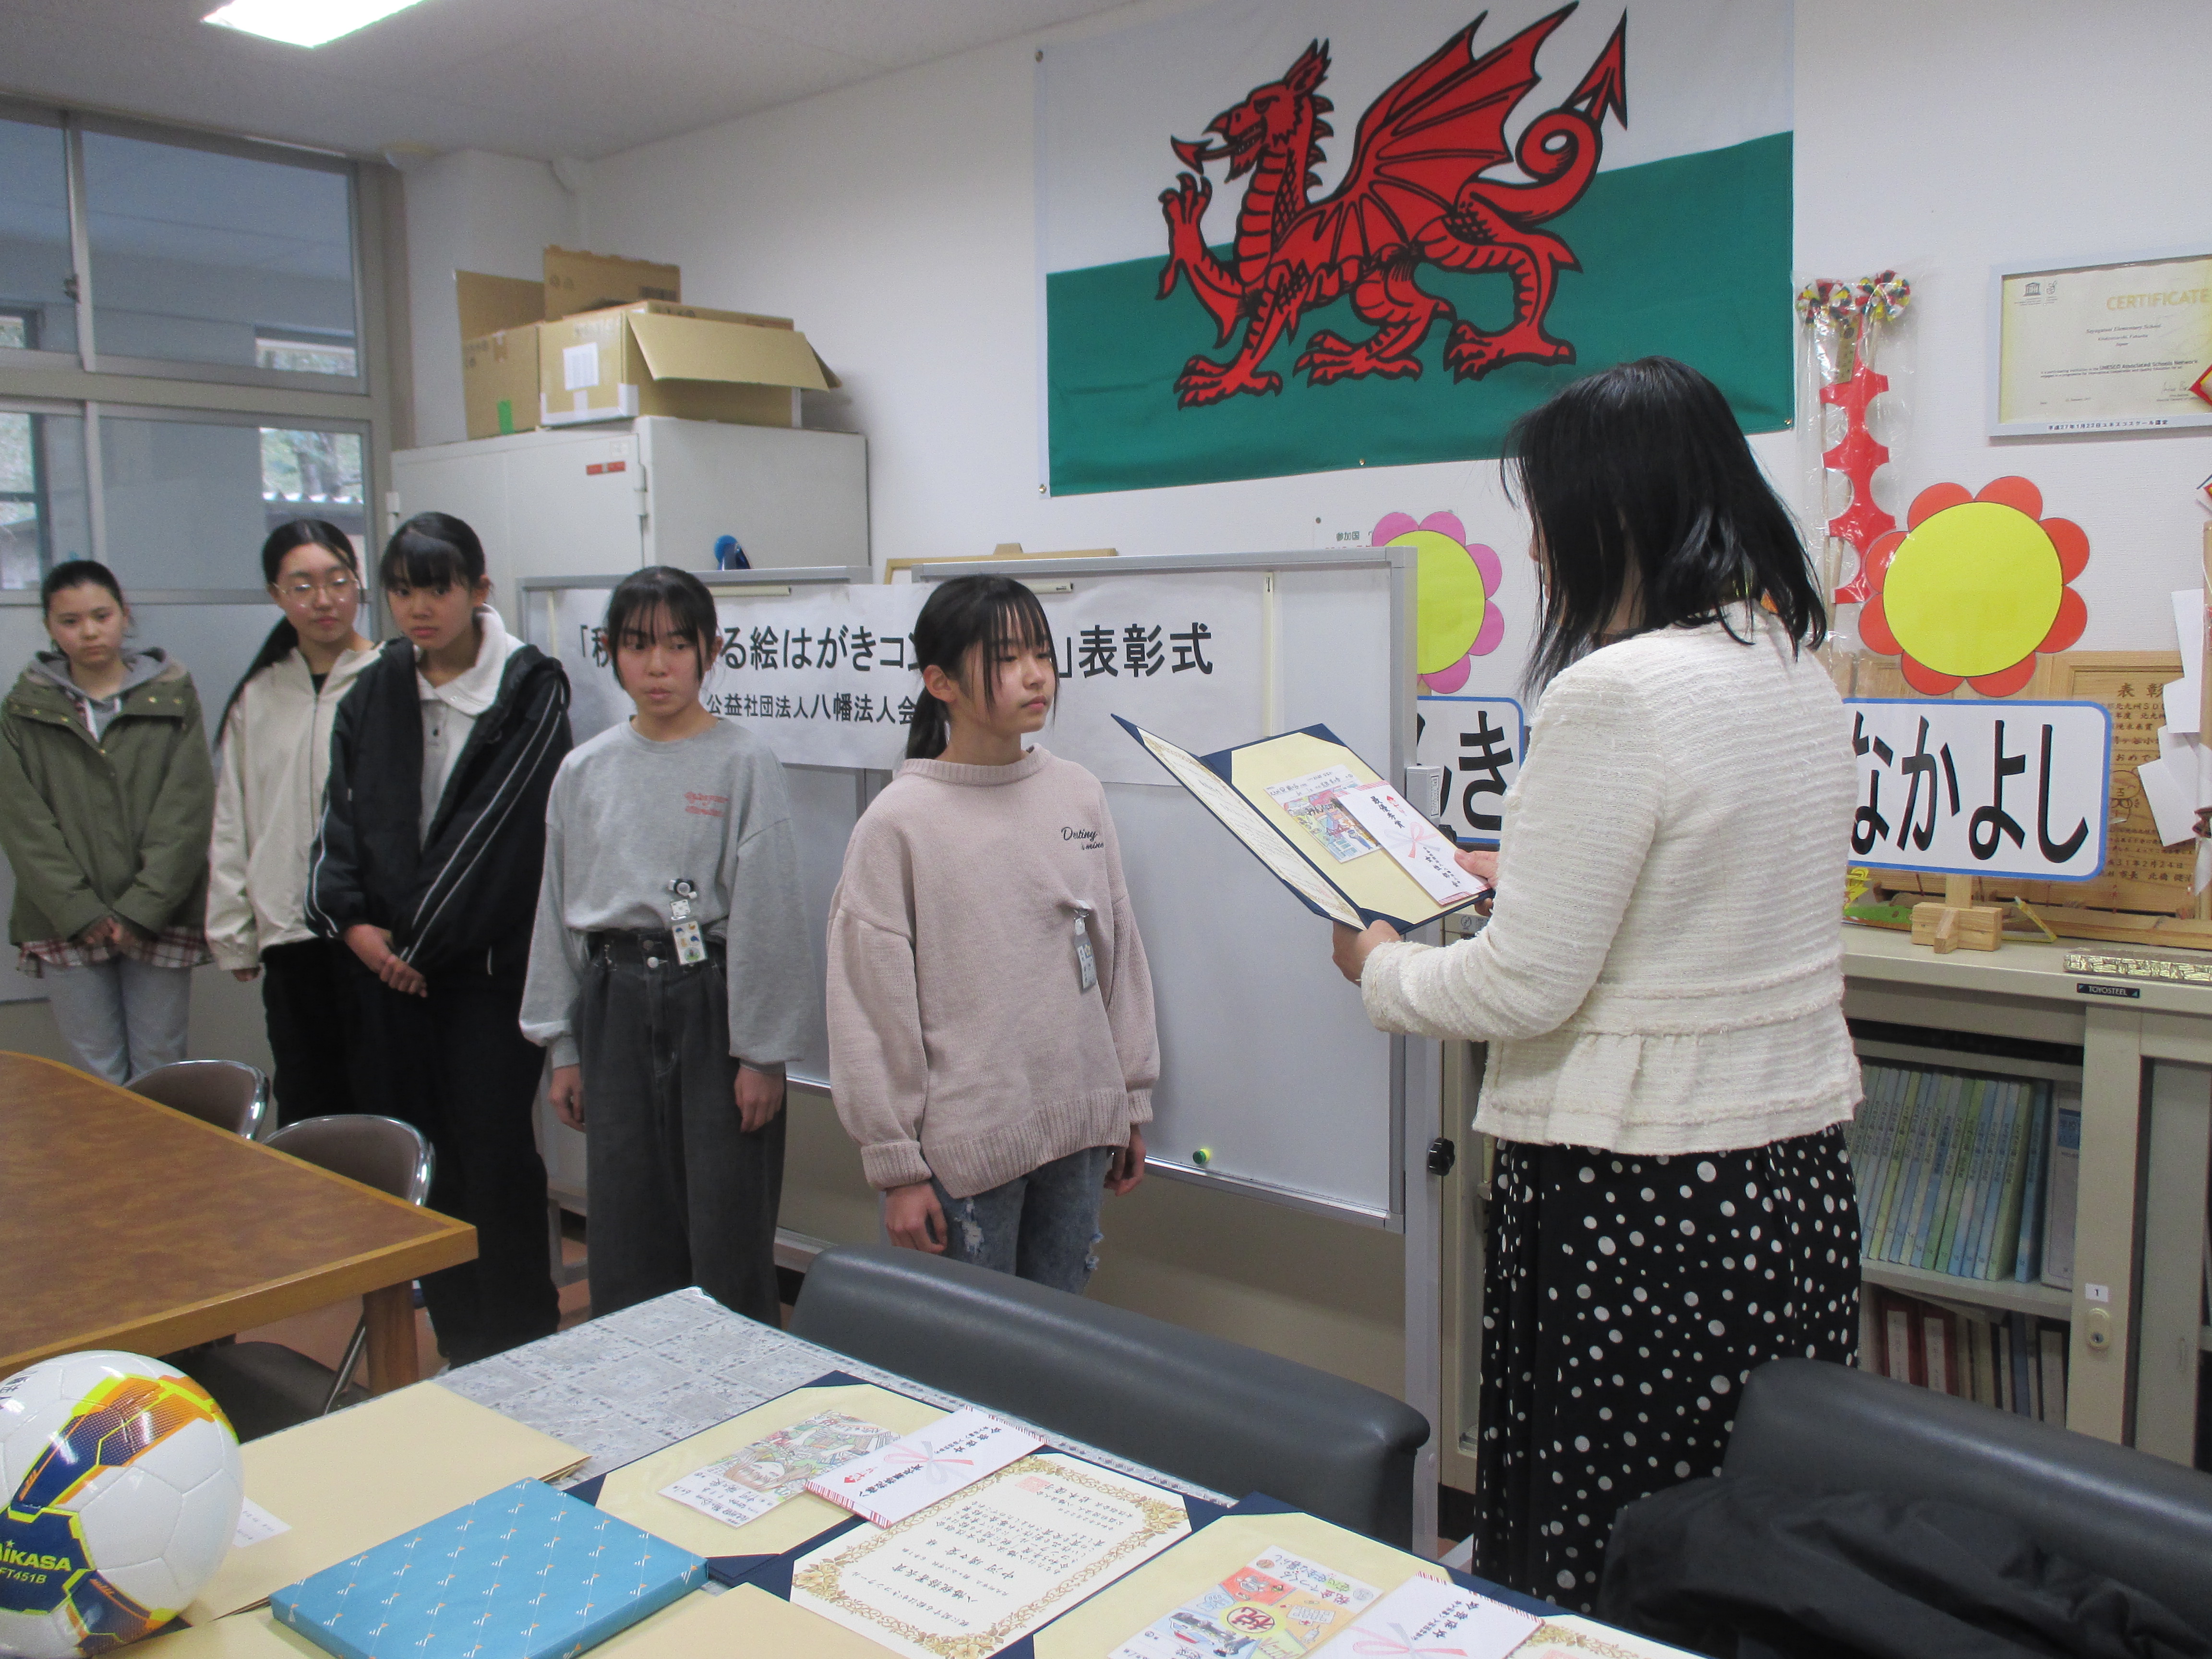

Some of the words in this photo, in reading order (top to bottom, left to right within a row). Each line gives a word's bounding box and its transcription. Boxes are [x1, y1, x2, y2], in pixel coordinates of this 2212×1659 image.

[2106, 289, 2209, 311] CERTIFICATE
[1336, 531, 1360, 541] 参加国
[1851, 710, 2088, 863] なかよし
[1370, 795, 1406, 829] 最優秀賞
[2089, 986, 2128, 996] TOYOSTEEL
[0, 1540, 72, 1571] IKASA
[891, 1563, 978, 1603] 八幡税務署長賞
